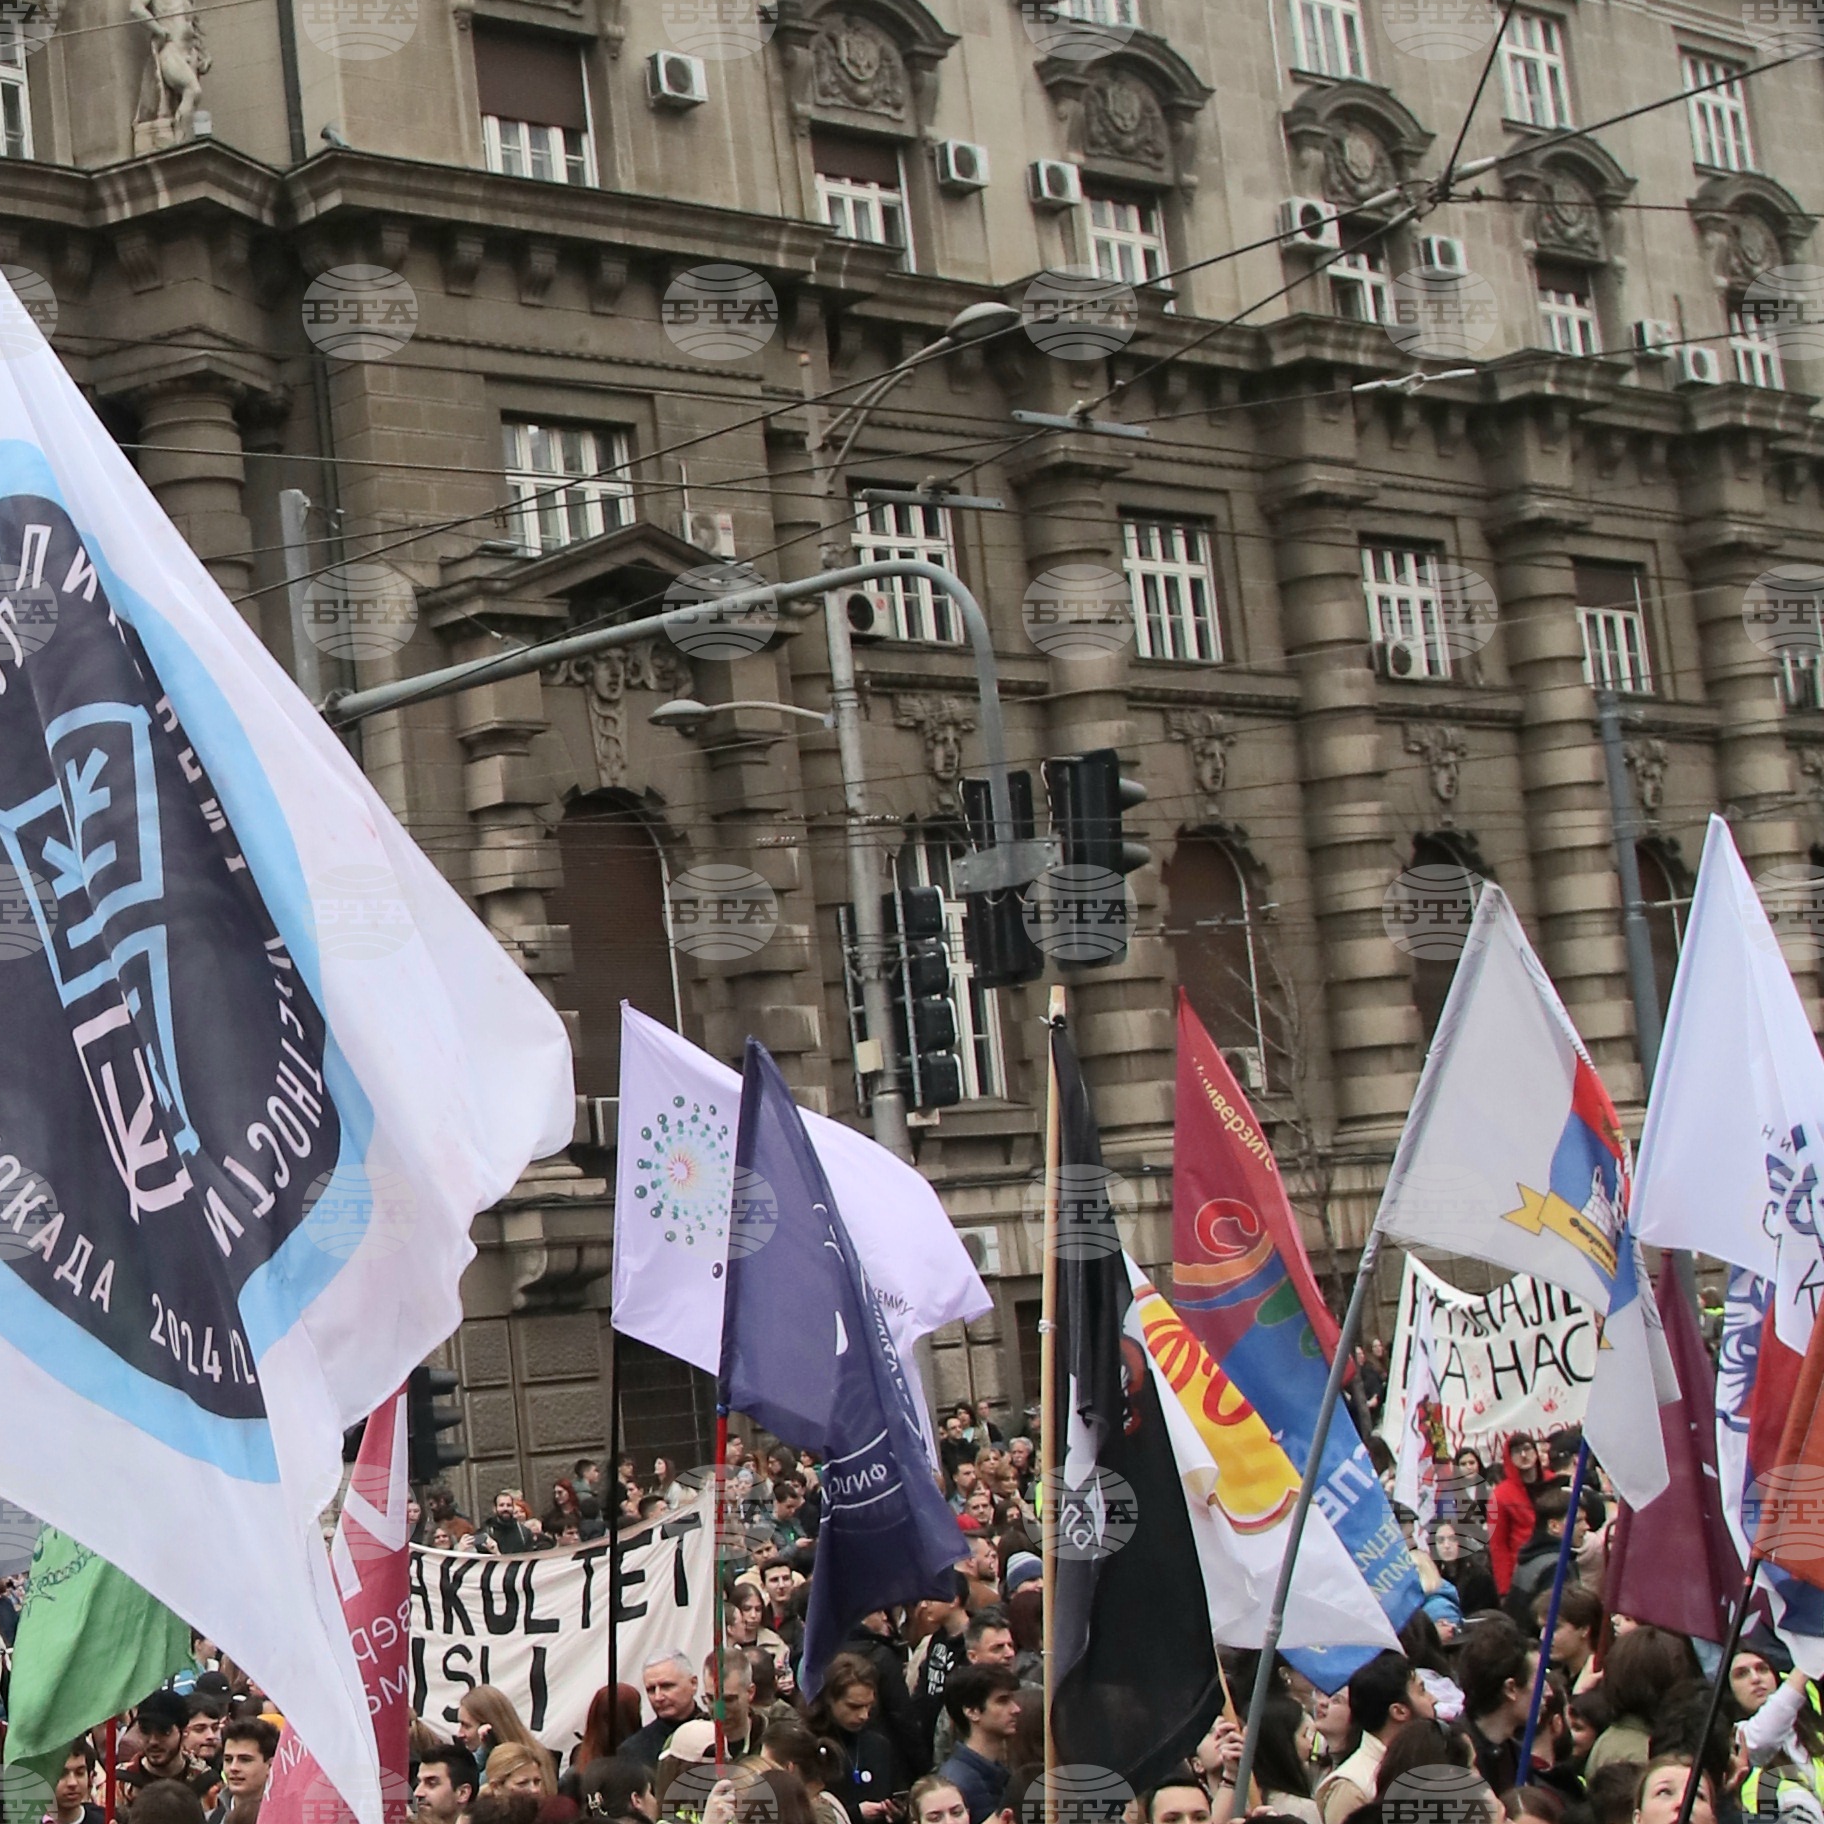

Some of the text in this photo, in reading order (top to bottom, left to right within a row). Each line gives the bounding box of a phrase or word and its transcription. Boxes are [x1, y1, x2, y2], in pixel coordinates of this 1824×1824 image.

[149, 1292, 257, 1385] 2024/2
[1487, 1321, 1594, 1401] НАС
[408, 1512, 702, 1636] AKULTET
